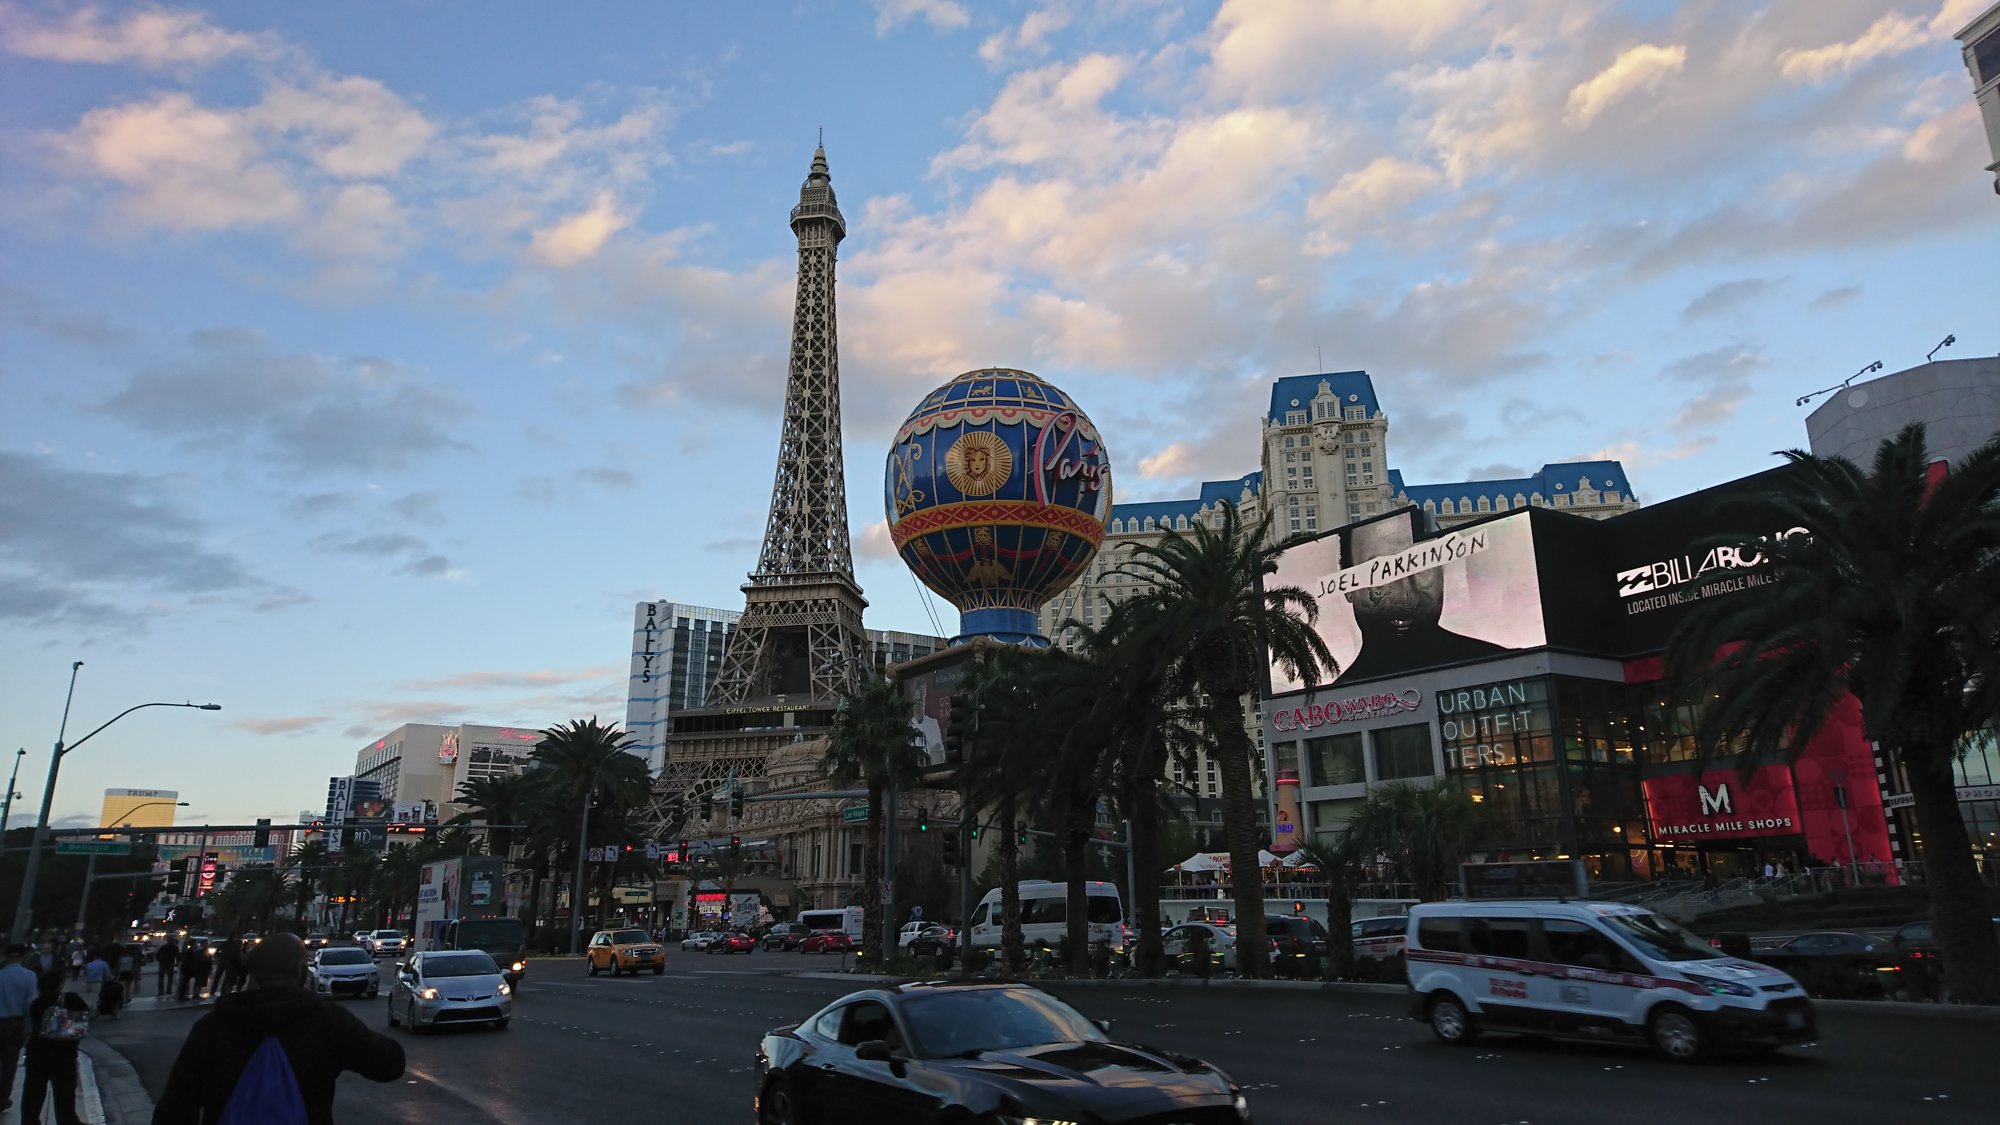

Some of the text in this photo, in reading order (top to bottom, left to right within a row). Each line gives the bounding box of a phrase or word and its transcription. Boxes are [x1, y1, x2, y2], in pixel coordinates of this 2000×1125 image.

[1033, 409, 1110, 508] Paris
[1317, 533, 1484, 598] JOEL PARKINSON
[1628, 595, 1667, 614] LOCATED
[1669, 590, 1700, 606] INSDE
[1702, 577, 1745, 598] MIRACLE
[773, 704, 810, 712] RESTAURANT
[1273, 692, 1397, 731] CABO WABO
[1440, 683, 1525, 713] URBAN
[1444, 711, 1531, 740] OUTFIT
[1446, 744, 1506, 769] TERS
[1698, 783, 1731, 815] M
[1659, 818, 1791, 835] MIRACLE MILE SHOPS
